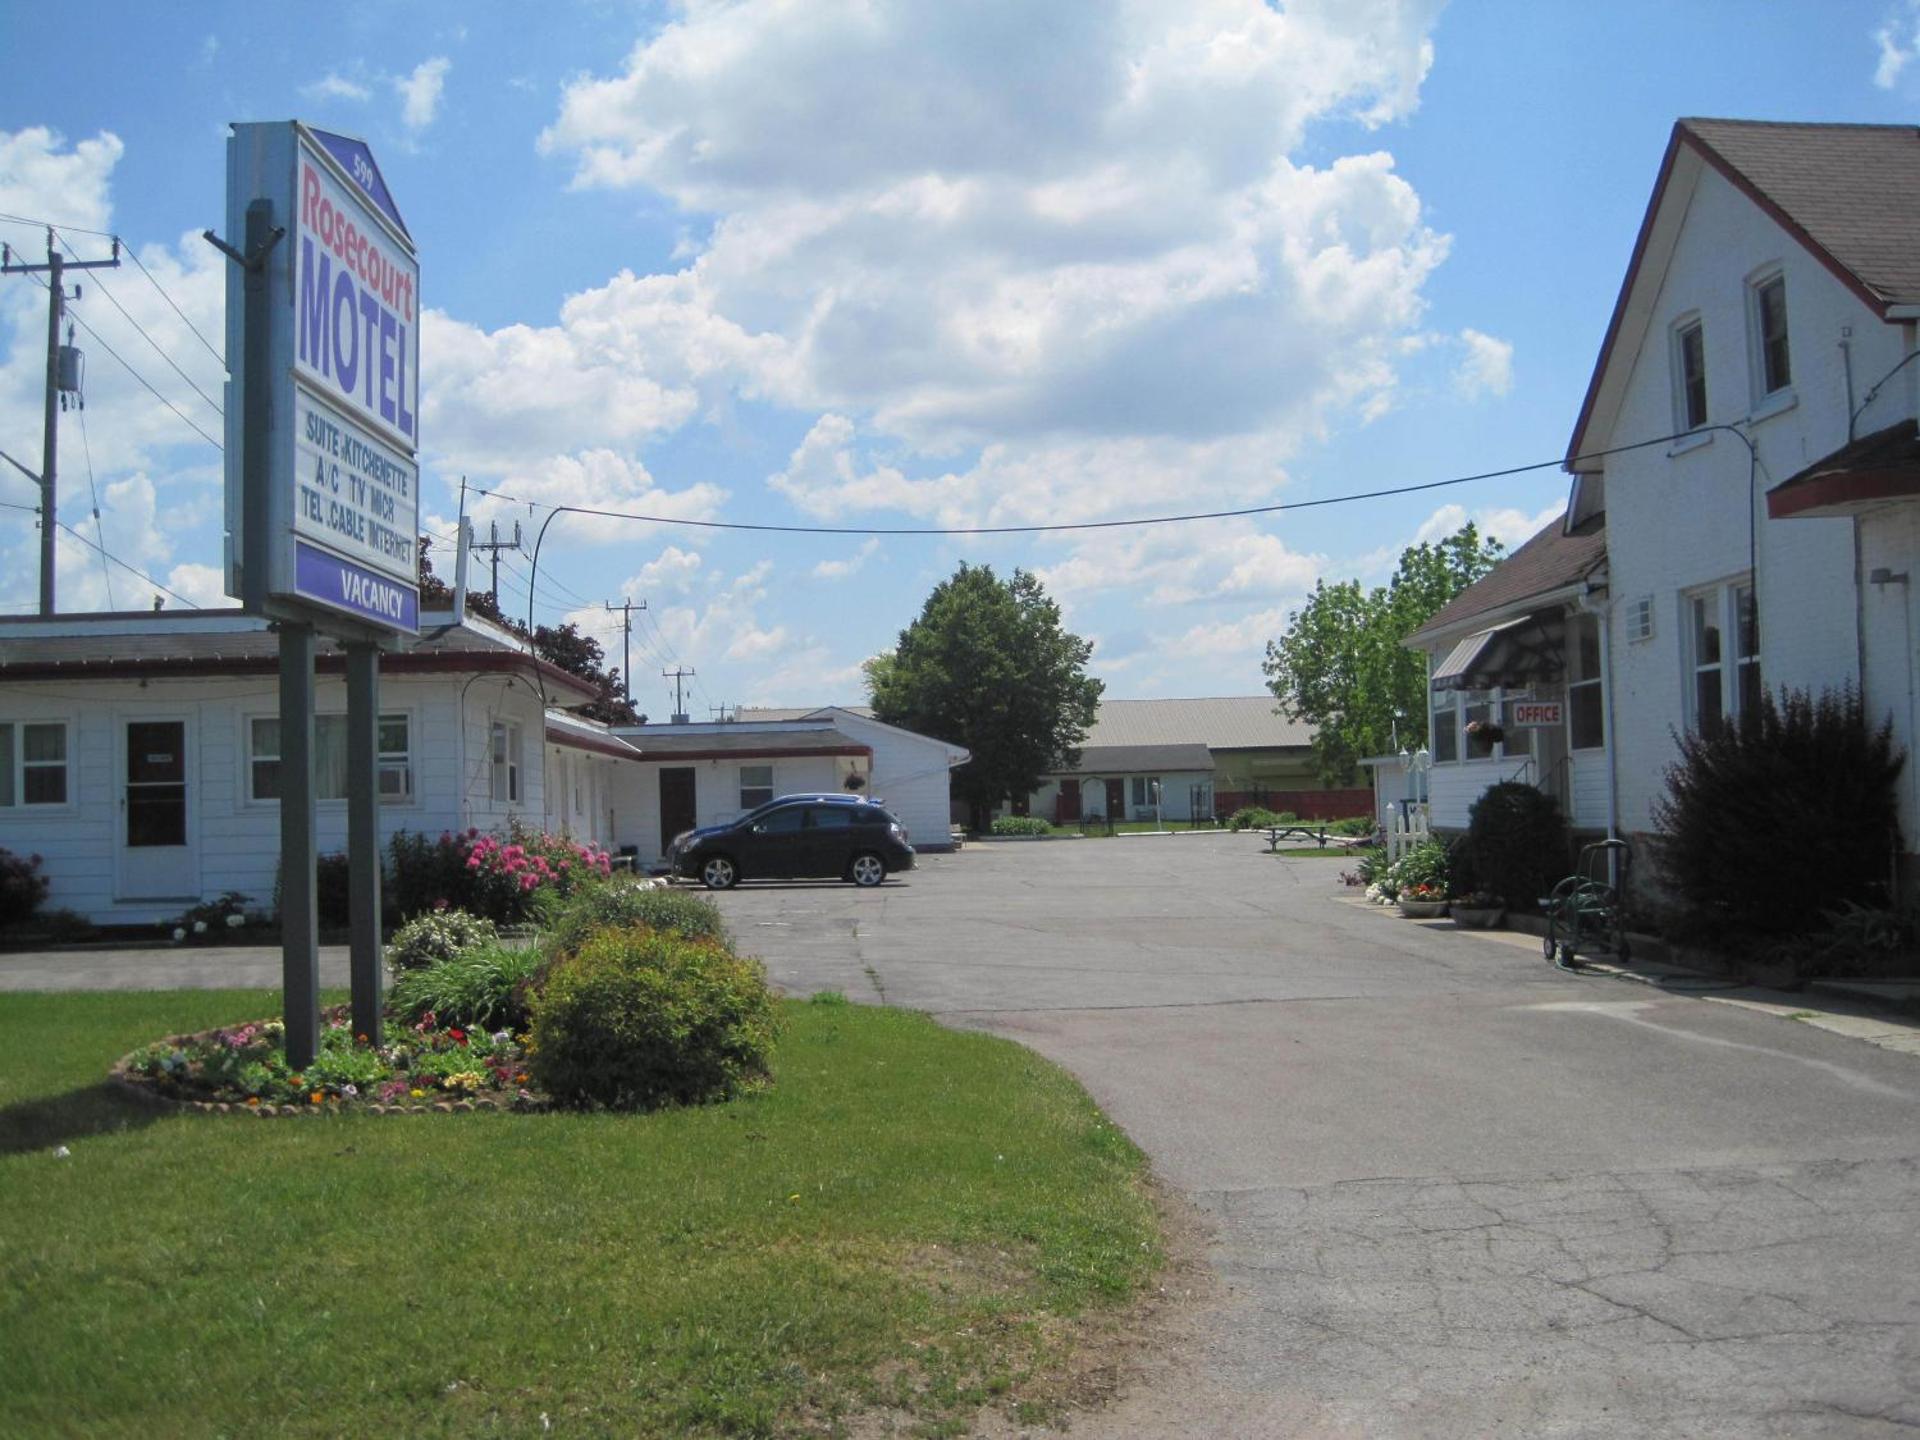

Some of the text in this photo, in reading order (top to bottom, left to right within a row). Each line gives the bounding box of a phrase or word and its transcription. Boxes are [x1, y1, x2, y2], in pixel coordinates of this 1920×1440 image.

[353, 154, 373, 190] 599
[302, 162, 412, 322] Rosecourt
[300, 235, 412, 439] MOTEL
[306, 411, 339, 457] SUITE
[315, 455, 339, 493] A/C
[350, 474, 366, 508] TV
[301, 485, 323, 523] TEL
[369, 519, 411, 564] INTERNET
[341, 569, 404, 620] VACANCY
[1516, 705, 1560, 722] OFFICE
